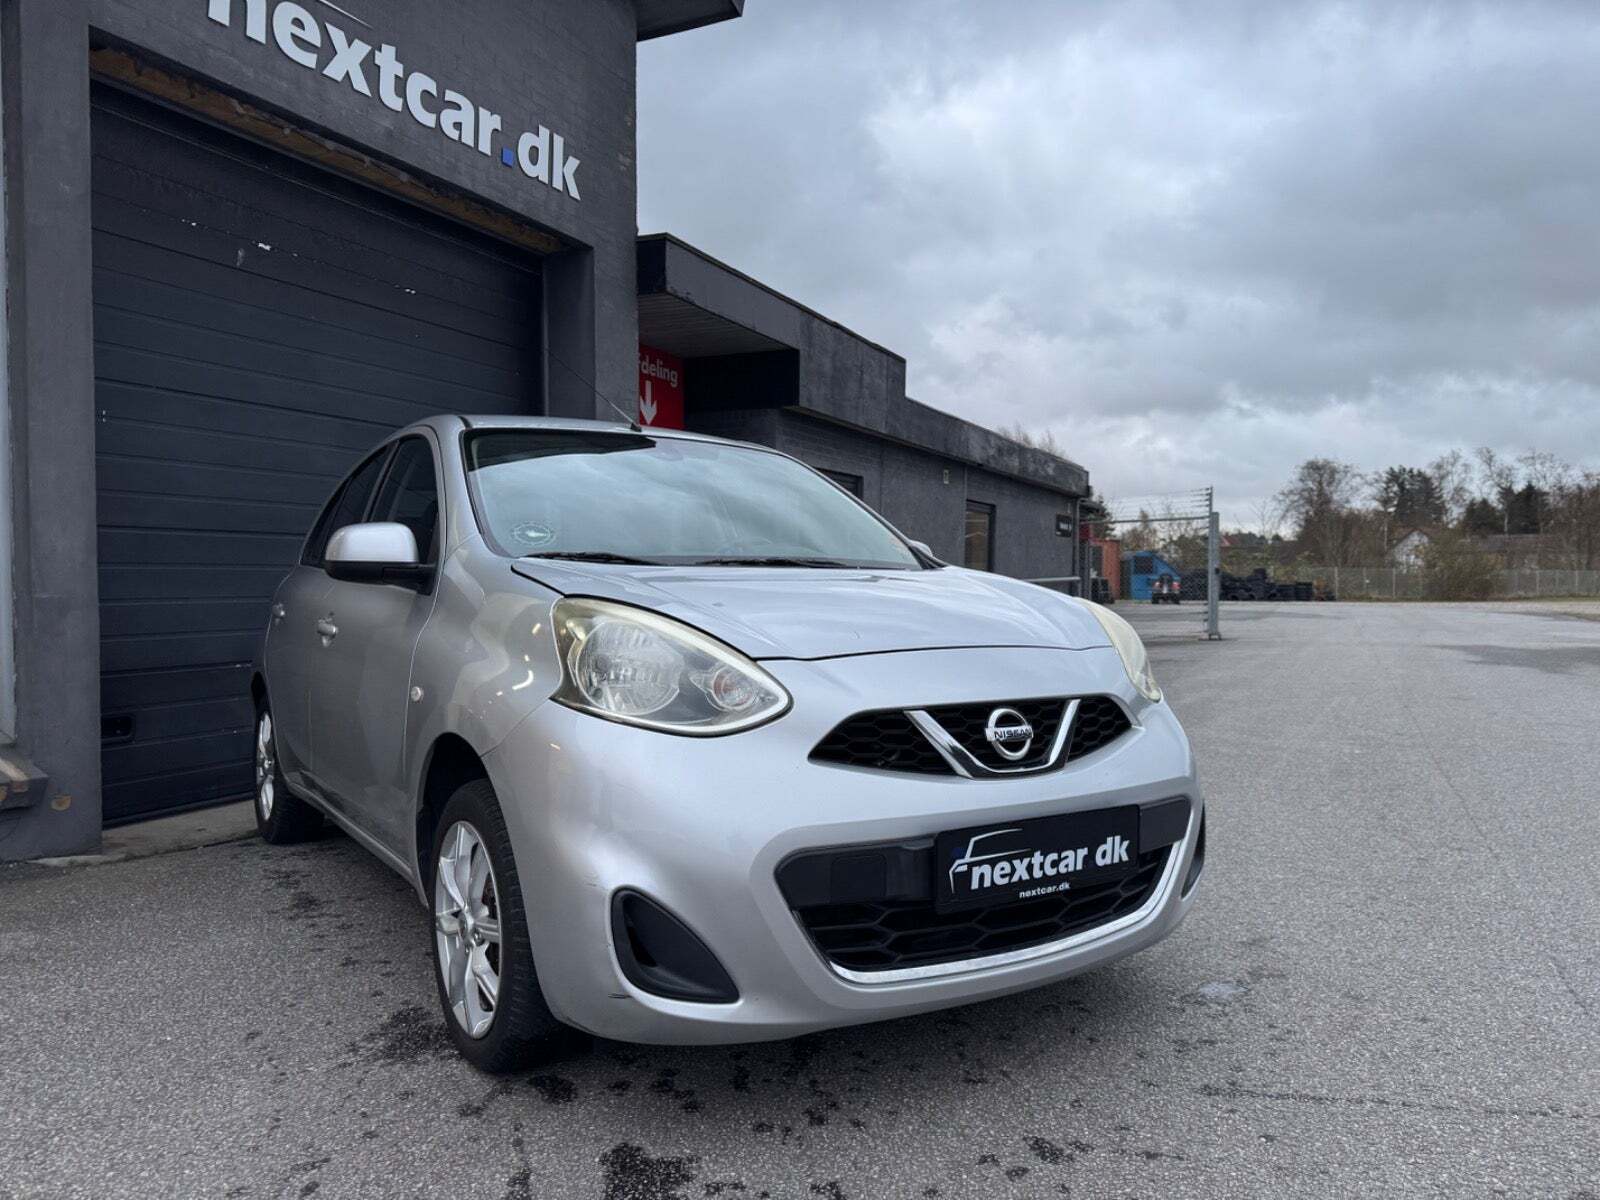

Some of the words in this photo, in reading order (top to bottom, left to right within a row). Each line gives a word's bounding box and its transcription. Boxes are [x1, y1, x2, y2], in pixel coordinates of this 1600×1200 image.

[638, 354, 679, 388] deling
[994, 727, 1031, 738] NISSAN
[1018, 881, 1071, 898] nextcar.dk
